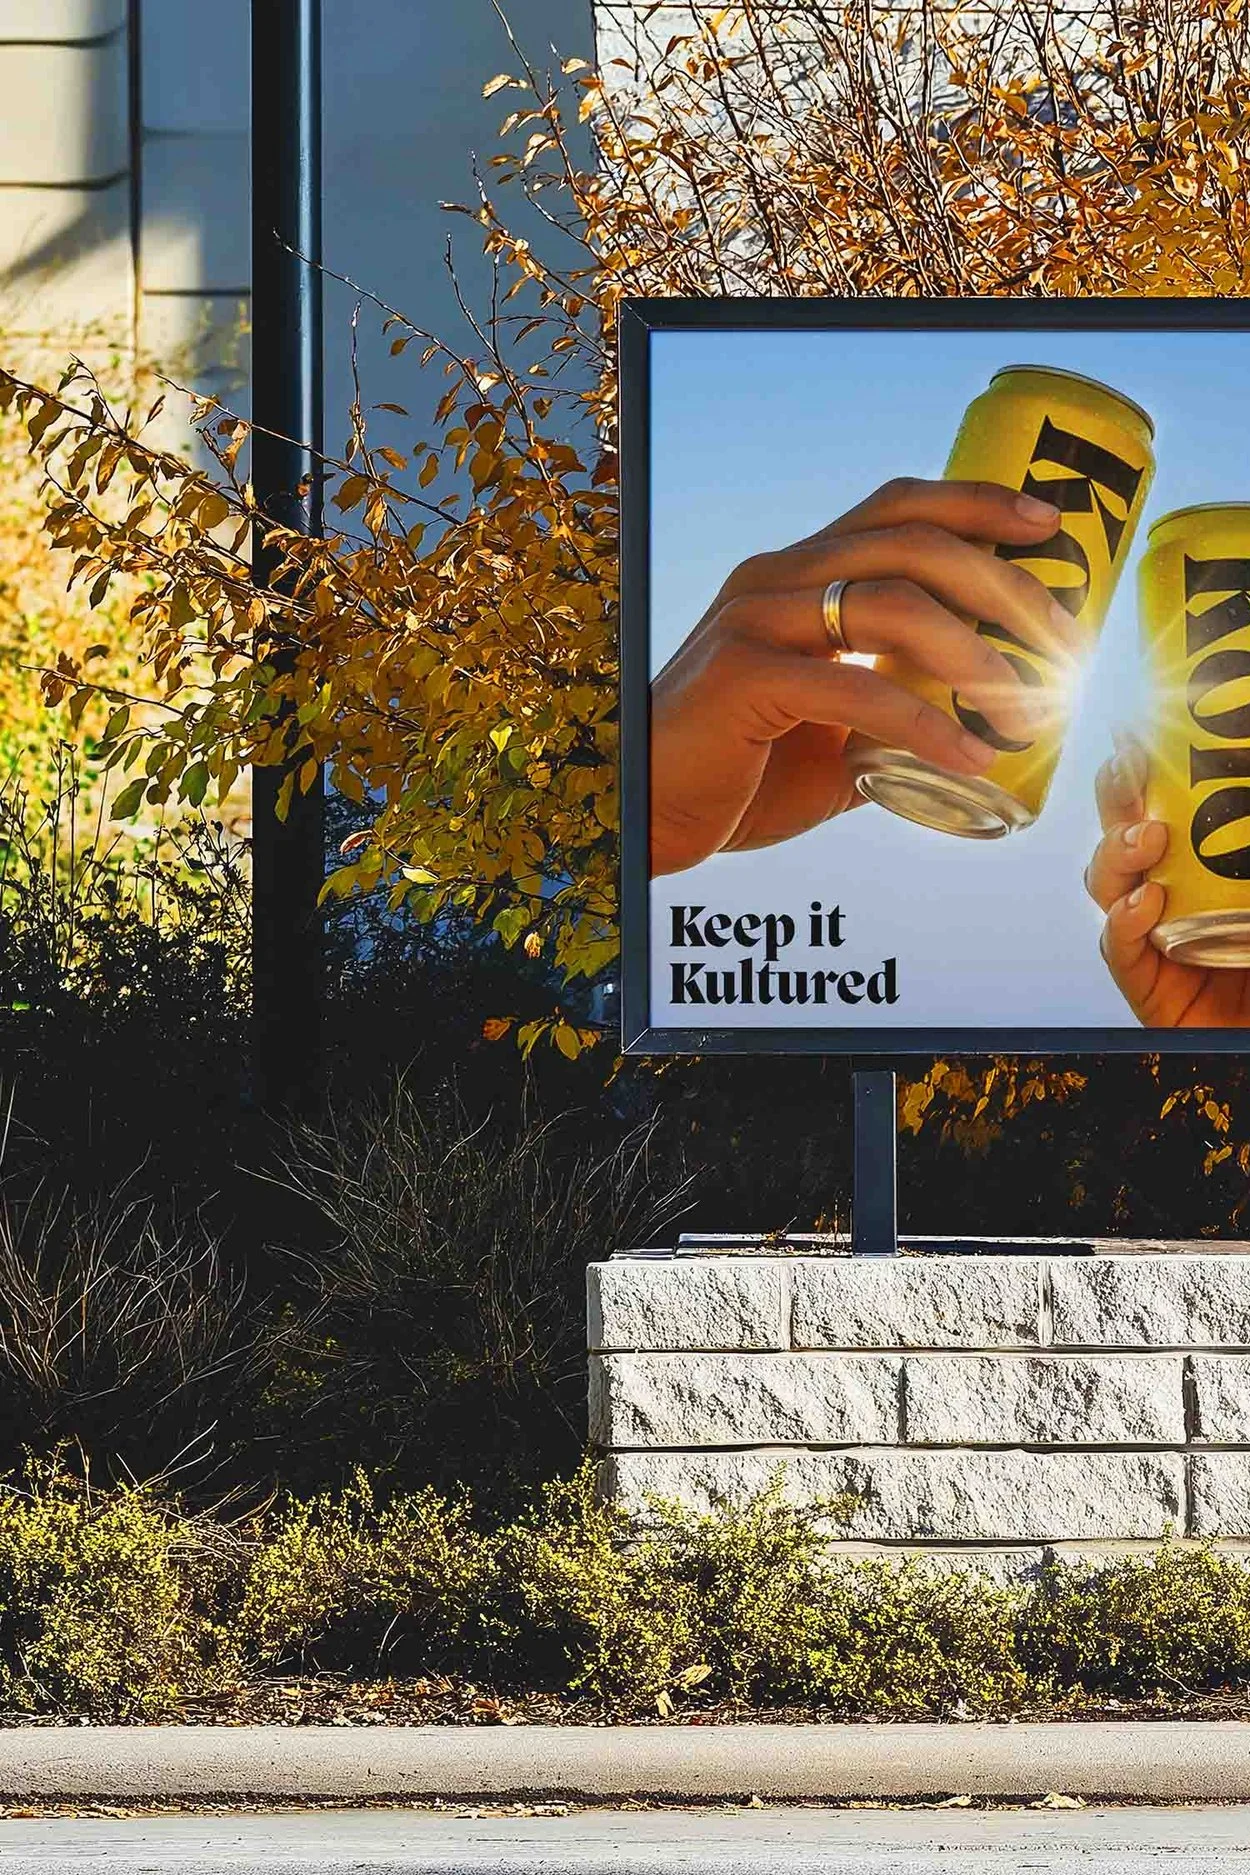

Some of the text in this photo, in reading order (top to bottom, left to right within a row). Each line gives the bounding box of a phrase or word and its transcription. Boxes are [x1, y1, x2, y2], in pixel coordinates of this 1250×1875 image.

[669, 901, 847, 962] Keep it
[669, 957, 901, 1005] Kultured
